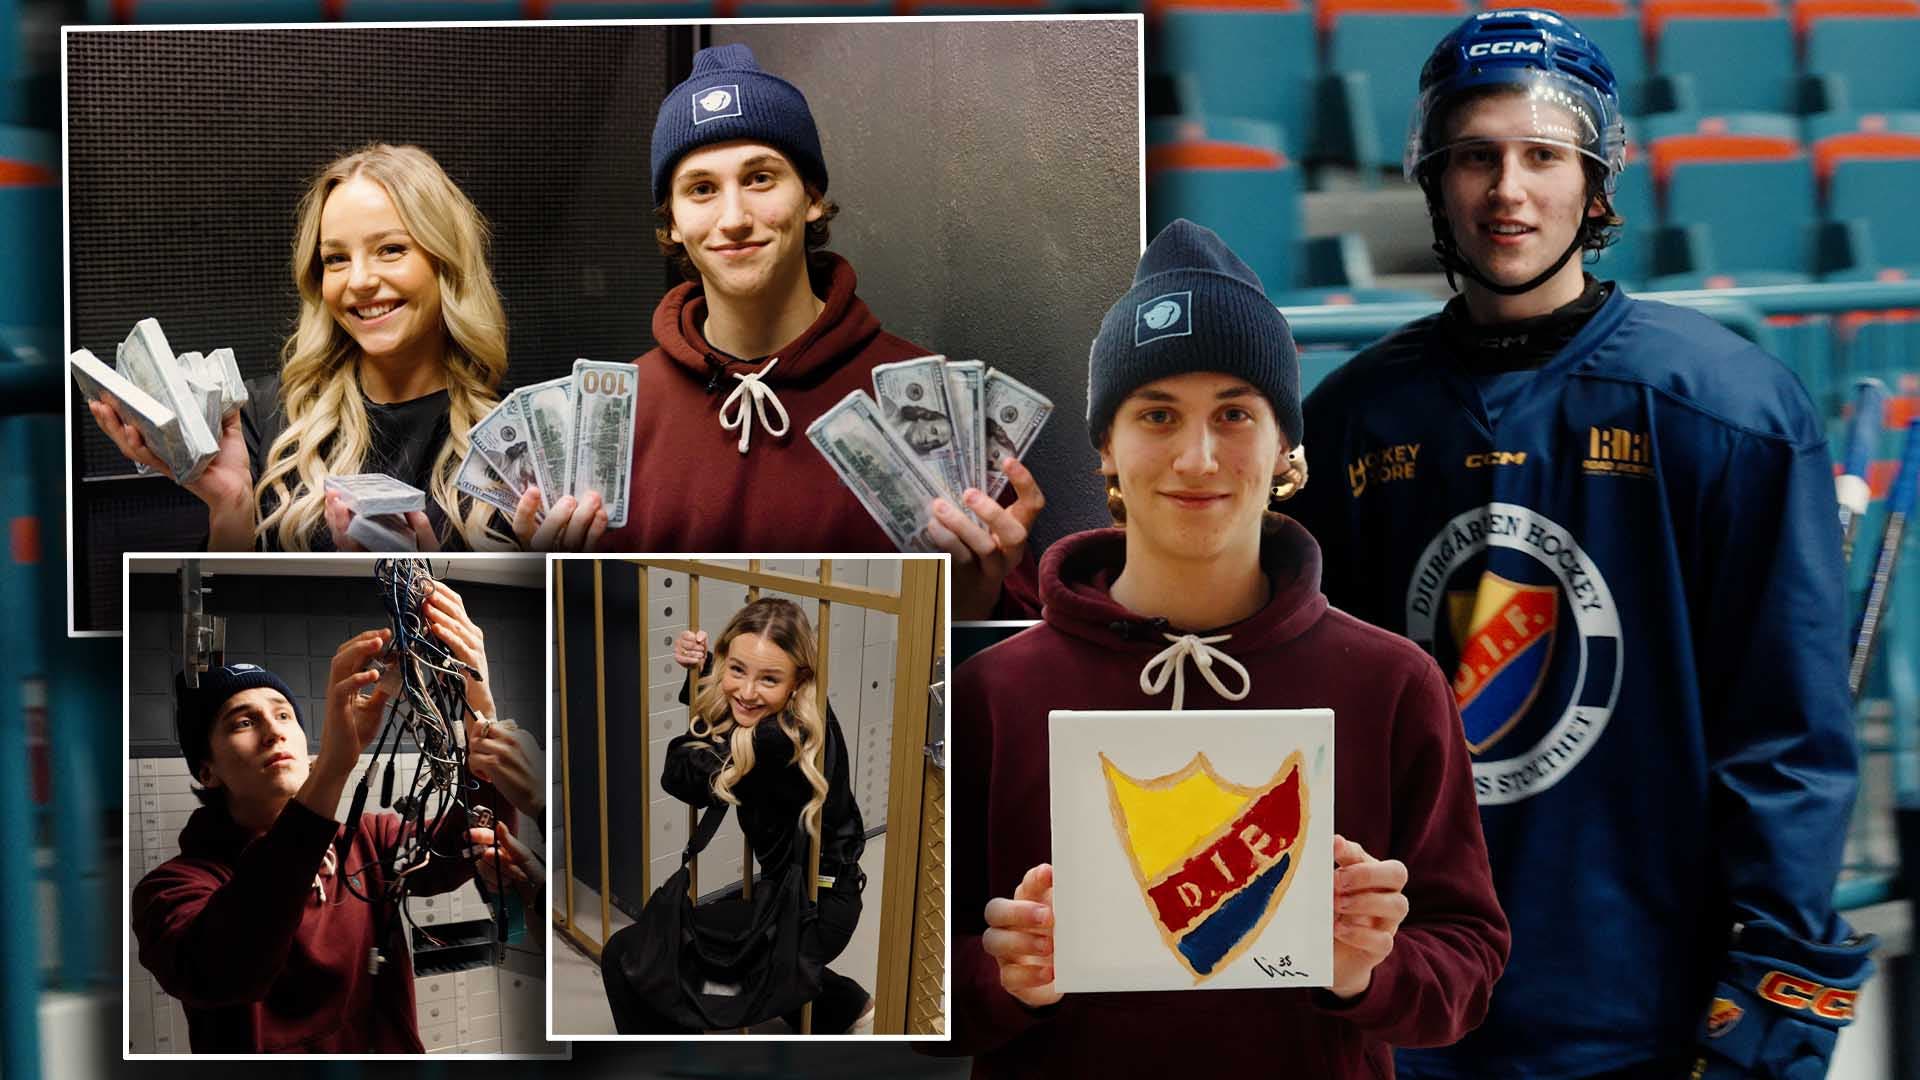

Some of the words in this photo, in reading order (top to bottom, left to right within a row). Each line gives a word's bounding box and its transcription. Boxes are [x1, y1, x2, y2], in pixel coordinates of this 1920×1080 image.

[1469, 41, 1544, 57] CCM
[583, 370, 628, 396] 100
[1465, 451, 1528, 468] CCM
[1524, 522, 1603, 612] HOCKEY
